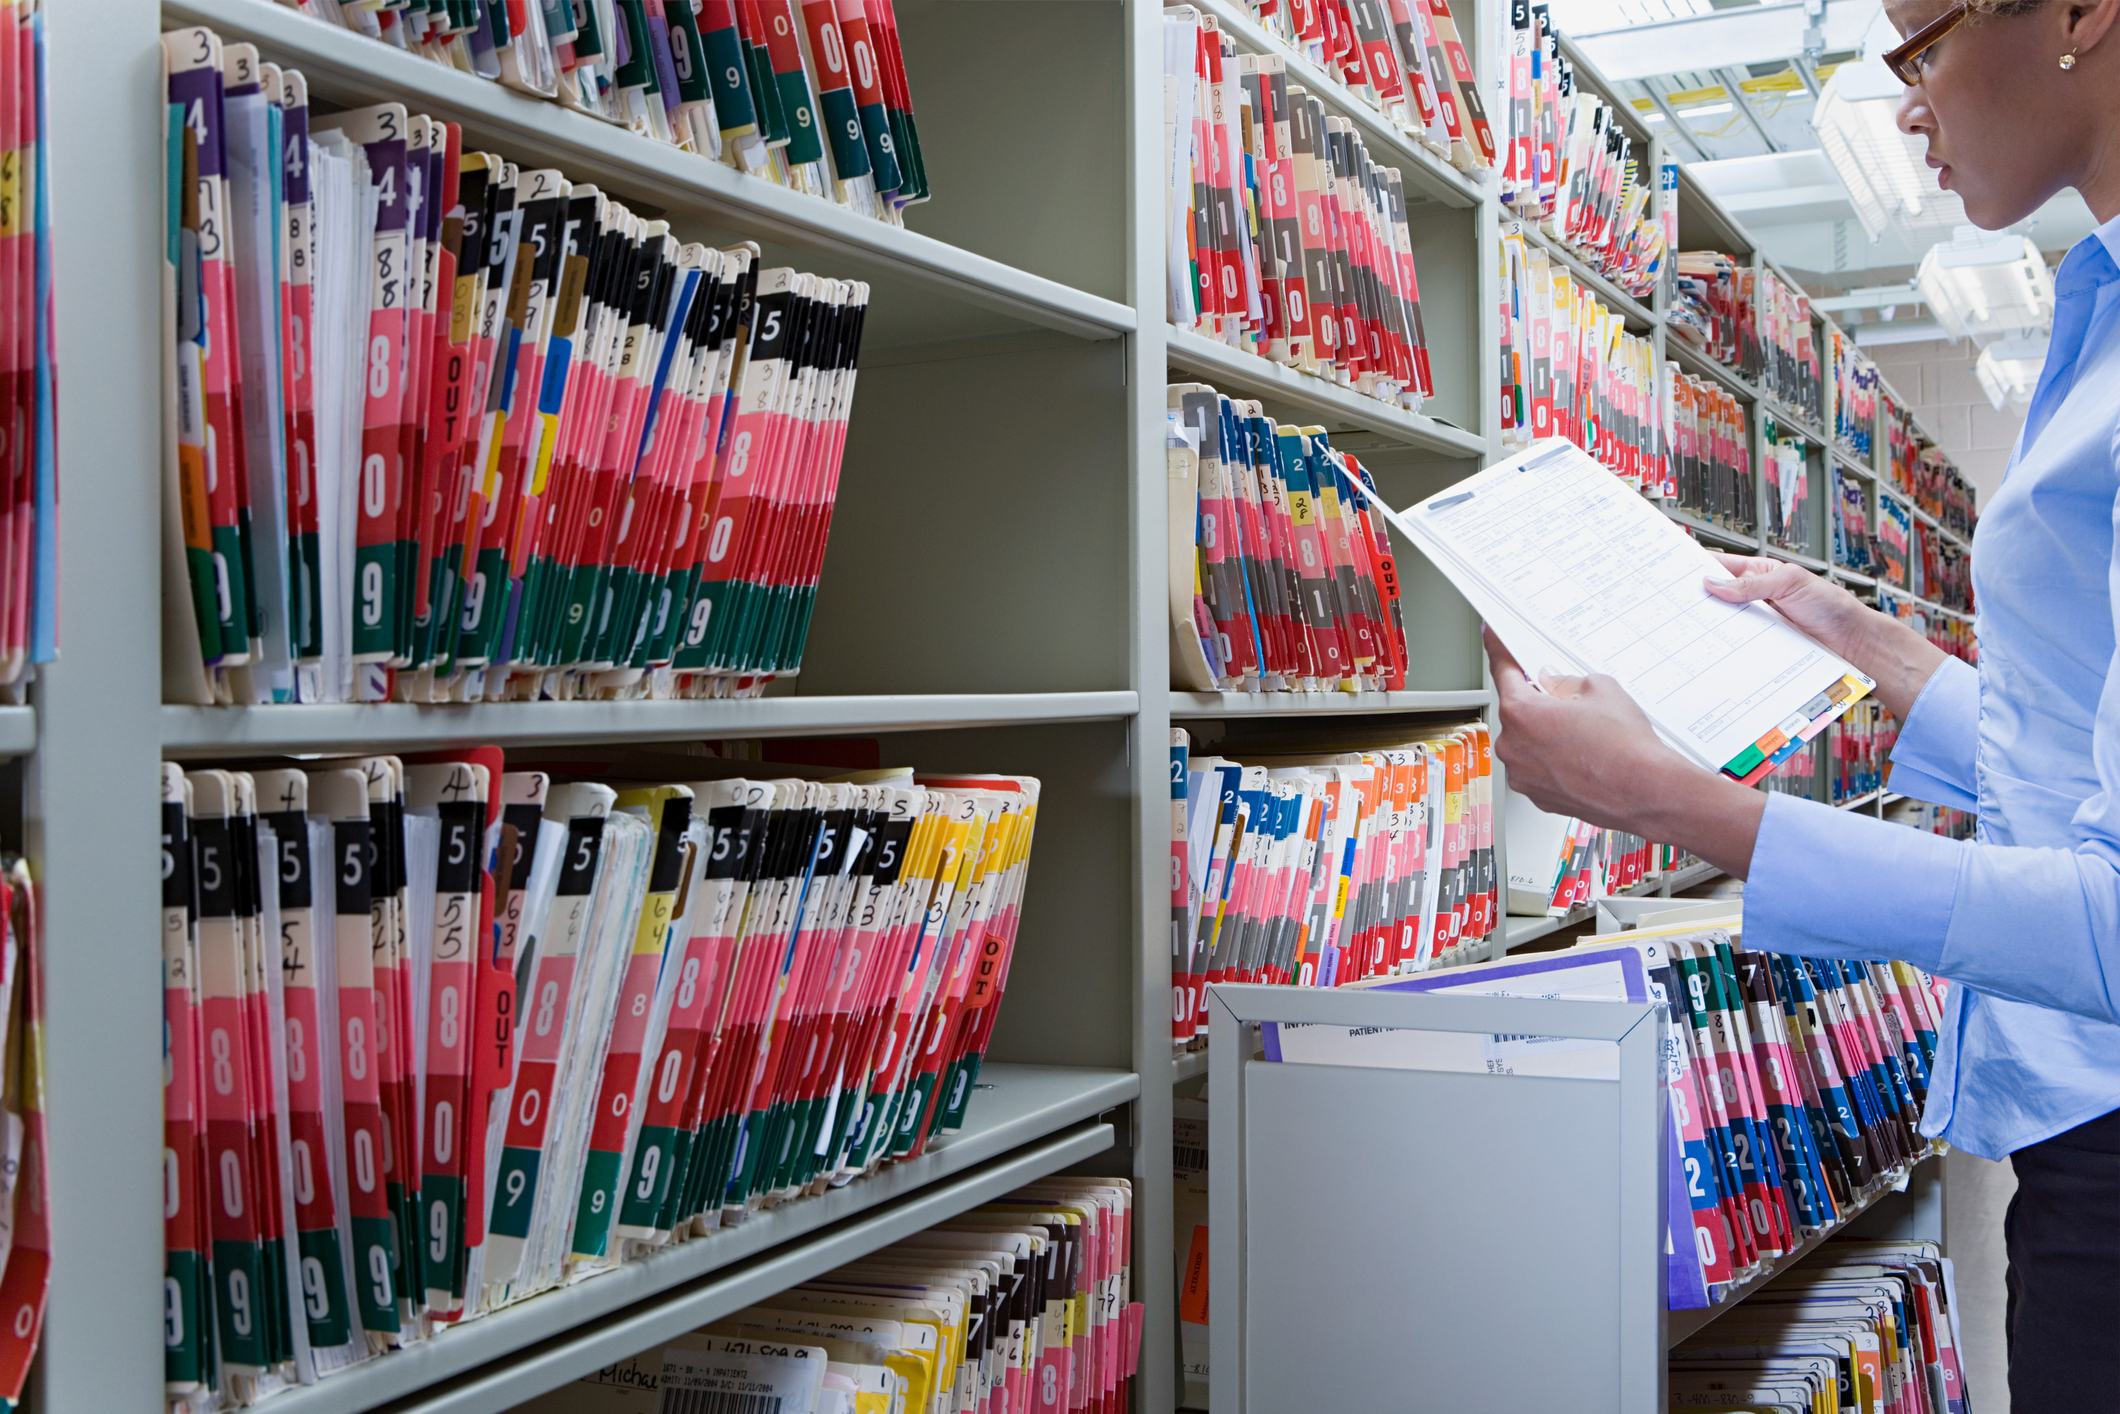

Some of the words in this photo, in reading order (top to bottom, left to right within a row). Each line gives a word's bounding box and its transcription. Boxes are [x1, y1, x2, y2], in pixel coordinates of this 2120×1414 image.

[774, 15, 788, 36] 0
[1515, 5, 1524, 21] 5
[1539, 13, 1547, 28] 5
[671, 25, 692, 80] 9
[821, 23, 842, 73] 0
[1410, 32, 1420, 62] 1
[725, 67, 741, 89] 9
[853, 40, 873, 89] 0
[1374, 52, 1389, 78] 0
[1517, 67, 1526, 91] 8
[796, 106, 811, 128] 9
[1297, 108, 1305, 139] 1
[1443, 102, 1455, 126] 0
[1542, 150, 1551, 173] 0
[379, 165, 397, 207] 4
[531, 174, 552, 199] 2
[1272, 175, 1286, 206] 8
[463, 212, 479, 237] 5
[1200, 207, 1207, 222] 1
[1308, 204, 1319, 235] 8
[1282, 230, 1292, 262] 1
[1200, 274, 1209, 288] 0
[1223, 265, 1237, 298] 0
[1317, 260, 1325, 291] 1
[1535, 269, 1544, 283] 6
[1289, 290, 1304, 322] 0
[1555, 285, 1564, 299] 6
[761, 310, 782, 341] 5
[1321, 315, 1332, 345] 0
[1537, 326, 1546, 348] 8
[370, 335, 390, 398] 8
[1555, 341, 1564, 362] 8
[1583, 363, 1591, 390] OUT
[446, 356, 461, 442] OUT
[1502, 395, 1511, 419] 0
[1197, 407, 1206, 441] 1
[1537, 405, 1546, 428] 0
[730, 431, 752, 477] 8
[1294, 459, 1303, 471] 2
[1321, 455, 1331, 465] 2
[364, 453, 385, 518] 0
[1363, 476, 1370, 486] 2
[708, 516, 733, 563] 0
[1301, 539, 1314, 567] 8
[1339, 538, 1348, 548] 8
[362, 562, 382, 625] 9
[1381, 561, 1395, 596] OUT
[568, 603, 583, 624] 9
[1313, 590, 1324, 617] 1
[687, 598, 712, 645] 9
[1360, 629, 1369, 639] 0
[1329, 647, 1338, 658] 0
[1170, 761, 1183, 783] 2
[1398, 754, 1405, 765] 3
[1453, 764, 1460, 774] 3
[1224, 791, 1233, 803] 2
[1395, 783, 1404, 793] 3
[1391, 813, 1399, 826] 3
[448, 826, 465, 864] 5
[573, 837, 593, 871] 5
[712, 828, 732, 861] 5
[879, 841, 897, 868] 5
[1449, 842, 1456, 852] 8
[203, 847, 221, 891] 5
[282, 841, 301, 883] 5
[343, 844, 362, 886] 5
[1310, 915, 1318, 941] 1
[1475, 911, 1482, 921] 0
[1438, 930, 1447, 940] 0
[678, 958, 700, 1008] 8
[975, 942, 999, 995] OUT
[1742, 964, 1756, 987] 7
[1793, 968, 1805, 979] 2
[632, 994, 646, 1016] 8
[1688, 974, 1705, 1011] 9
[440, 986, 458, 1047] 8
[536, 981, 558, 1036] 8
[1715, 1015, 1722, 1028] 8
[1914, 1004, 1923, 1015] 8
[496, 991, 510, 1068] OUT
[211, 1028, 233, 1095] 8
[285, 1017, 306, 1082] 8
[347, 1017, 367, 1080] 8
[659, 1050, 682, 1103] 0
[1766, 1057, 1784, 1091] 8
[1893, 1073, 1903, 1084] 2
[1906, 1053, 1923, 1078] 2
[1877, 1083, 1888, 1093] 2
[520, 1089, 540, 1126] 0
[612, 1093, 627, 1117] 0
[1838, 1106, 1850, 1118] 2
[434, 1101, 453, 1164] 0
[354, 1129, 375, 1193] 0
[1734, 1135, 1754, 1169] 2
[1854, 1155, 1862, 1166] 7
[220, 1150, 244, 1219] 0
[637, 1146, 660, 1199] 9
[1684, 1157, 1705, 1198] 2
[506, 1169, 526, 1207] 9
[591, 1190, 606, 1213] 9
[430, 1200, 448, 1263] 9
[1751, 1199, 1770, 1235] 0
[302, 1256, 330, 1320] 9
[369, 1245, 392, 1307] 9
[1190, 1252, 1203, 1295] ATTENTION
[229, 1269, 252, 1335] 9
[1043, 1365, 1056, 1405] 8
[1945, 1369, 1954, 1381] 8
